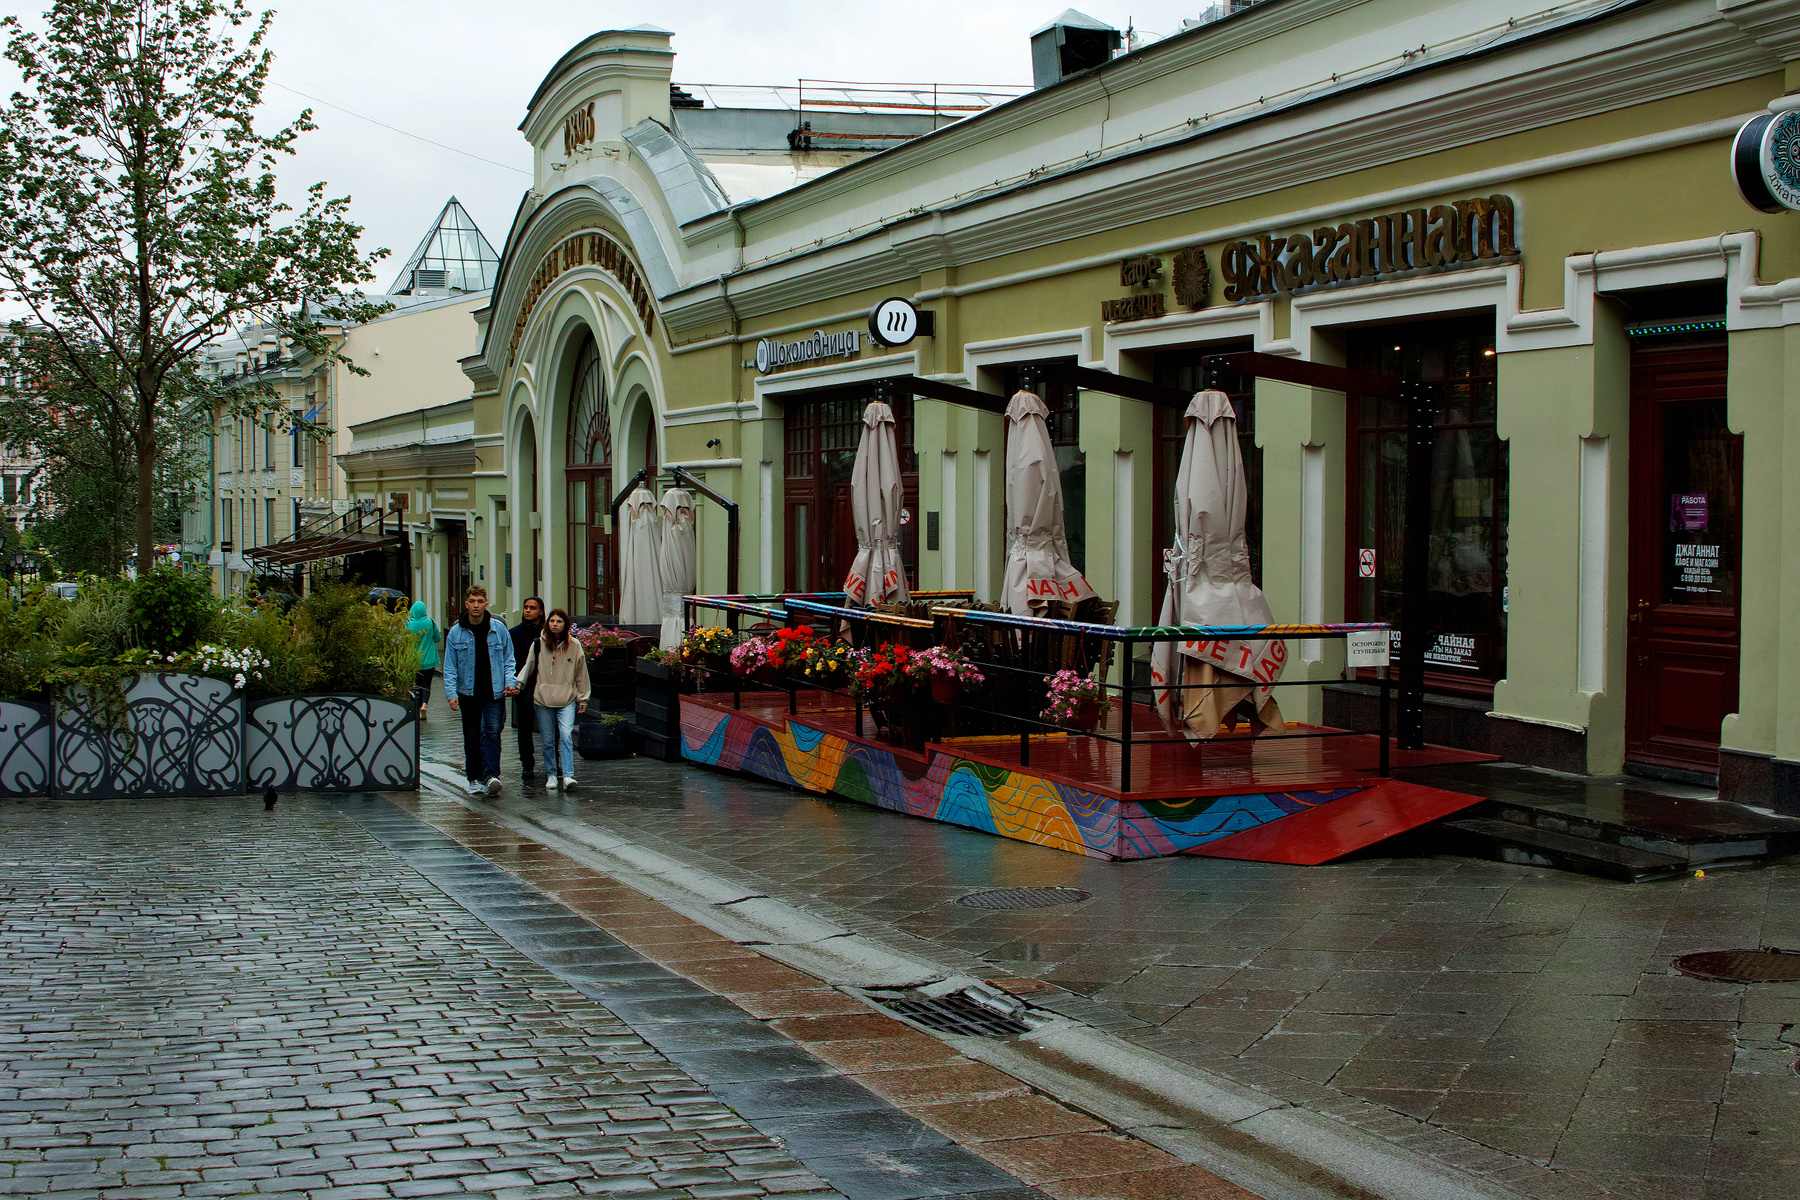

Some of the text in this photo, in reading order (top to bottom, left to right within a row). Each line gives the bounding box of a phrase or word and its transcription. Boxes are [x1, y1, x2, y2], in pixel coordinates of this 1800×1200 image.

[563, 101, 596, 156] 1896
[1681, 496, 1706, 504] РАБОТА
[1675, 544, 1720, 558] ДЖАГАННАТ
[1675, 558, 1689, 566] КАФЕ
[1694, 558, 1718, 568] МАГАЗИН
[1438, 634, 1475, 649] ЧАЙНАЯ
[1444, 646, 1453, 654] НА
[1453, 647, 1472, 657] ЗАКАЗ
